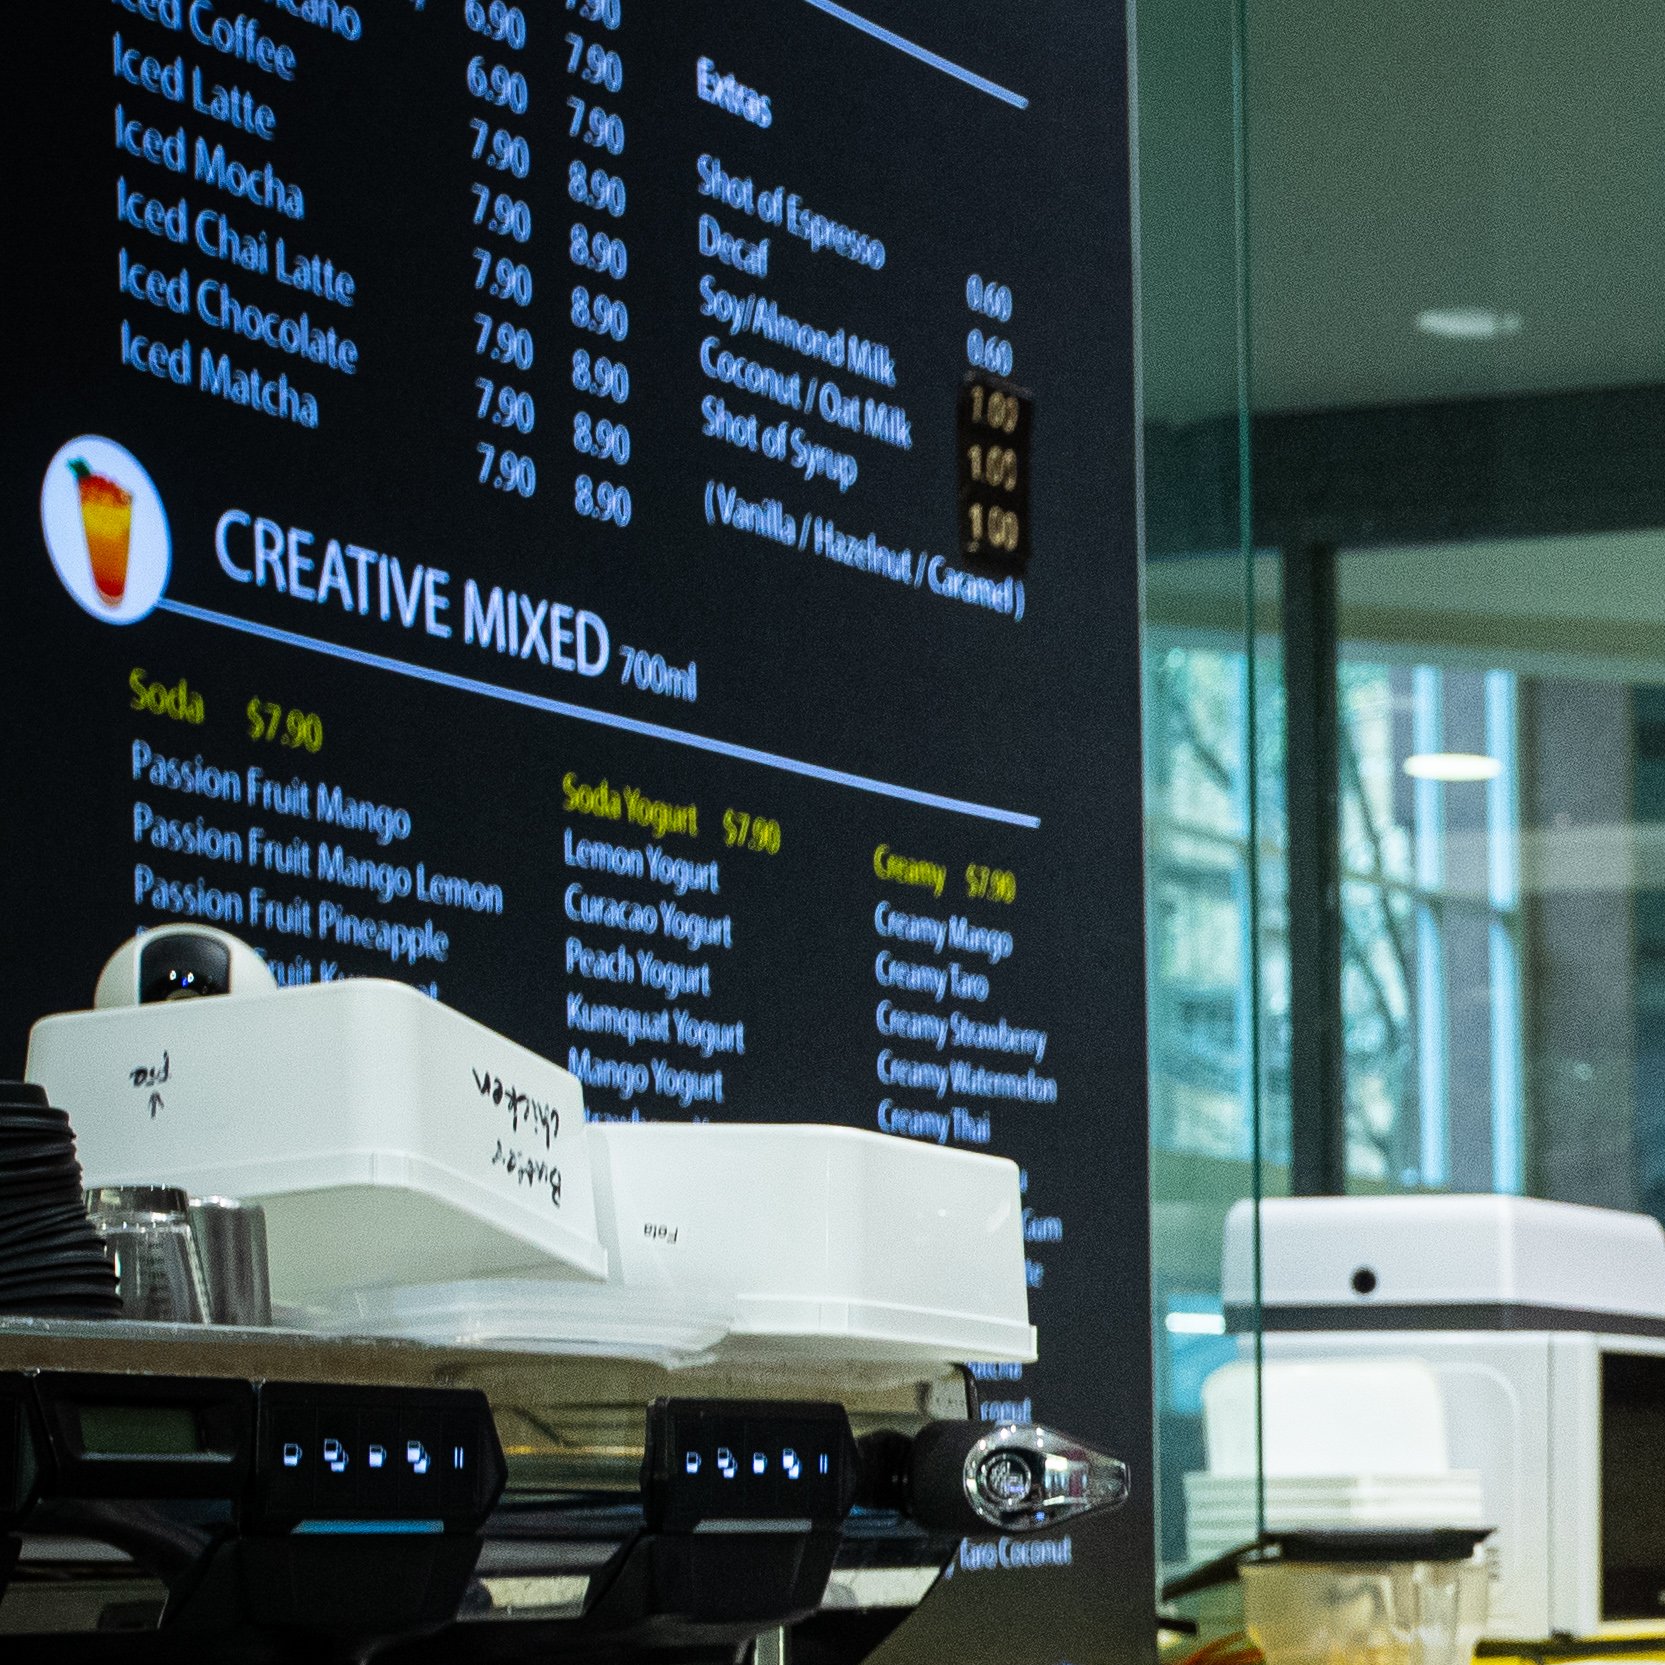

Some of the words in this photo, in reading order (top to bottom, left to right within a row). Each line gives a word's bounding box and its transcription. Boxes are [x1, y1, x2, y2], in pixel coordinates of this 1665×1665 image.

[190, 0, 296, 81] Coffee
[465, 0, 526, 49] 6.90
[113, 31, 185, 101] Iced
[193, 66, 275, 140] Latte
[467, 56, 528, 114] 6.90
[564, 32, 623, 93] 7.90
[697, 55, 773, 129] Extras
[470, 118, 530, 178] 7.90
[567, 95, 624, 155] 7.90
[115, 103, 186, 173] Iced
[195, 136, 305, 219] Mocha
[568, 160, 626, 217] 8.90
[117, 176, 188, 244] Iced
[195, 209, 269, 275] Chai
[276, 238, 356, 307] Latte
[471, 183, 531, 242] 7.90
[697, 153, 755, 215] Shot
[757, 185, 785, 227] of
[787, 193, 886, 270] Espresso
[472, 248, 532, 306] 7.90
[570, 223, 627, 280] 8.90
[698, 213, 771, 278] Decaf
[119, 247, 189, 314] Iced
[197, 279, 359, 374] Chocolate
[474, 313, 534, 369] 7.90
[571, 286, 628, 342] 8.90
[700, 274, 846, 366] Soy/Almond
[848, 335, 896, 388] Milk
[121, 320, 191, 385] Iced
[201, 347, 319, 428] Matcha
[475, 378, 535, 433] 7.90
[572, 349, 629, 404] 8.90
[700, 336, 801, 410] Coconut
[819, 382, 861, 432] Oat
[864, 398, 913, 450] Milk
[477, 442, 536, 498] 7.90
[574, 412, 631, 465] 8.90
[701, 394, 759, 452] Shot
[761, 421, 788, 461] of
[790, 427, 858, 493] Syrup
[575, 475, 632, 527] 8.90
[814, 515, 912, 584] Hazelnut
[215, 509, 452, 639] CREATIVE
[464, 578, 610, 678] MIXED
[619, 645, 697, 704] 700ml
[129, 667, 205, 725] Soda
[246, 695, 323, 754] $7.90
[132, 739, 241, 803] Passion
[247, 765, 310, 819] Fruit
[317, 782, 411, 846] Mango
[562, 771, 622, 820] Soda
[623, 784, 699, 839] Yogurt
[723, 807, 781, 856] $7.90
[133, 802, 242, 863] Passion
[248, 826, 311, 878] Fruit
[318, 842, 412, 903] Mango
[416, 861, 503, 914] Lemon
[564, 826, 644, 879] Lemon
[646, 843, 720, 895] Yogurt
[873, 843, 947, 898] Creamy
[134, 863, 243, 924] Passion
[249, 886, 311, 938] Fruit
[319, 899, 449, 965] Pineapple
[564, 882, 658, 935] Curacao
[660, 900, 733, 952] Yogurt
[874, 900, 947, 955] Creamy
[948, 914, 1014, 965] Mango
[565, 936, 635, 985] Peach
[636, 948, 712, 1000] Yogurt
[875, 950, 948, 1003] Creamy
[949, 962, 989, 1003] Taro
[566, 991, 670, 1047] Kumquat
[672, 1007, 745, 1057] Yogurt
[876, 999, 948, 1051] Creamy
[949, 1010, 1048, 1064] Strawberry
[568, 1045, 649, 1101] Mango
[651, 1058, 724, 1108] Yogurt
[877, 1048, 948, 1101] Creamy
[949, 1060, 1057, 1104] Watermelon
[878, 1097, 950, 1144] Creamy
